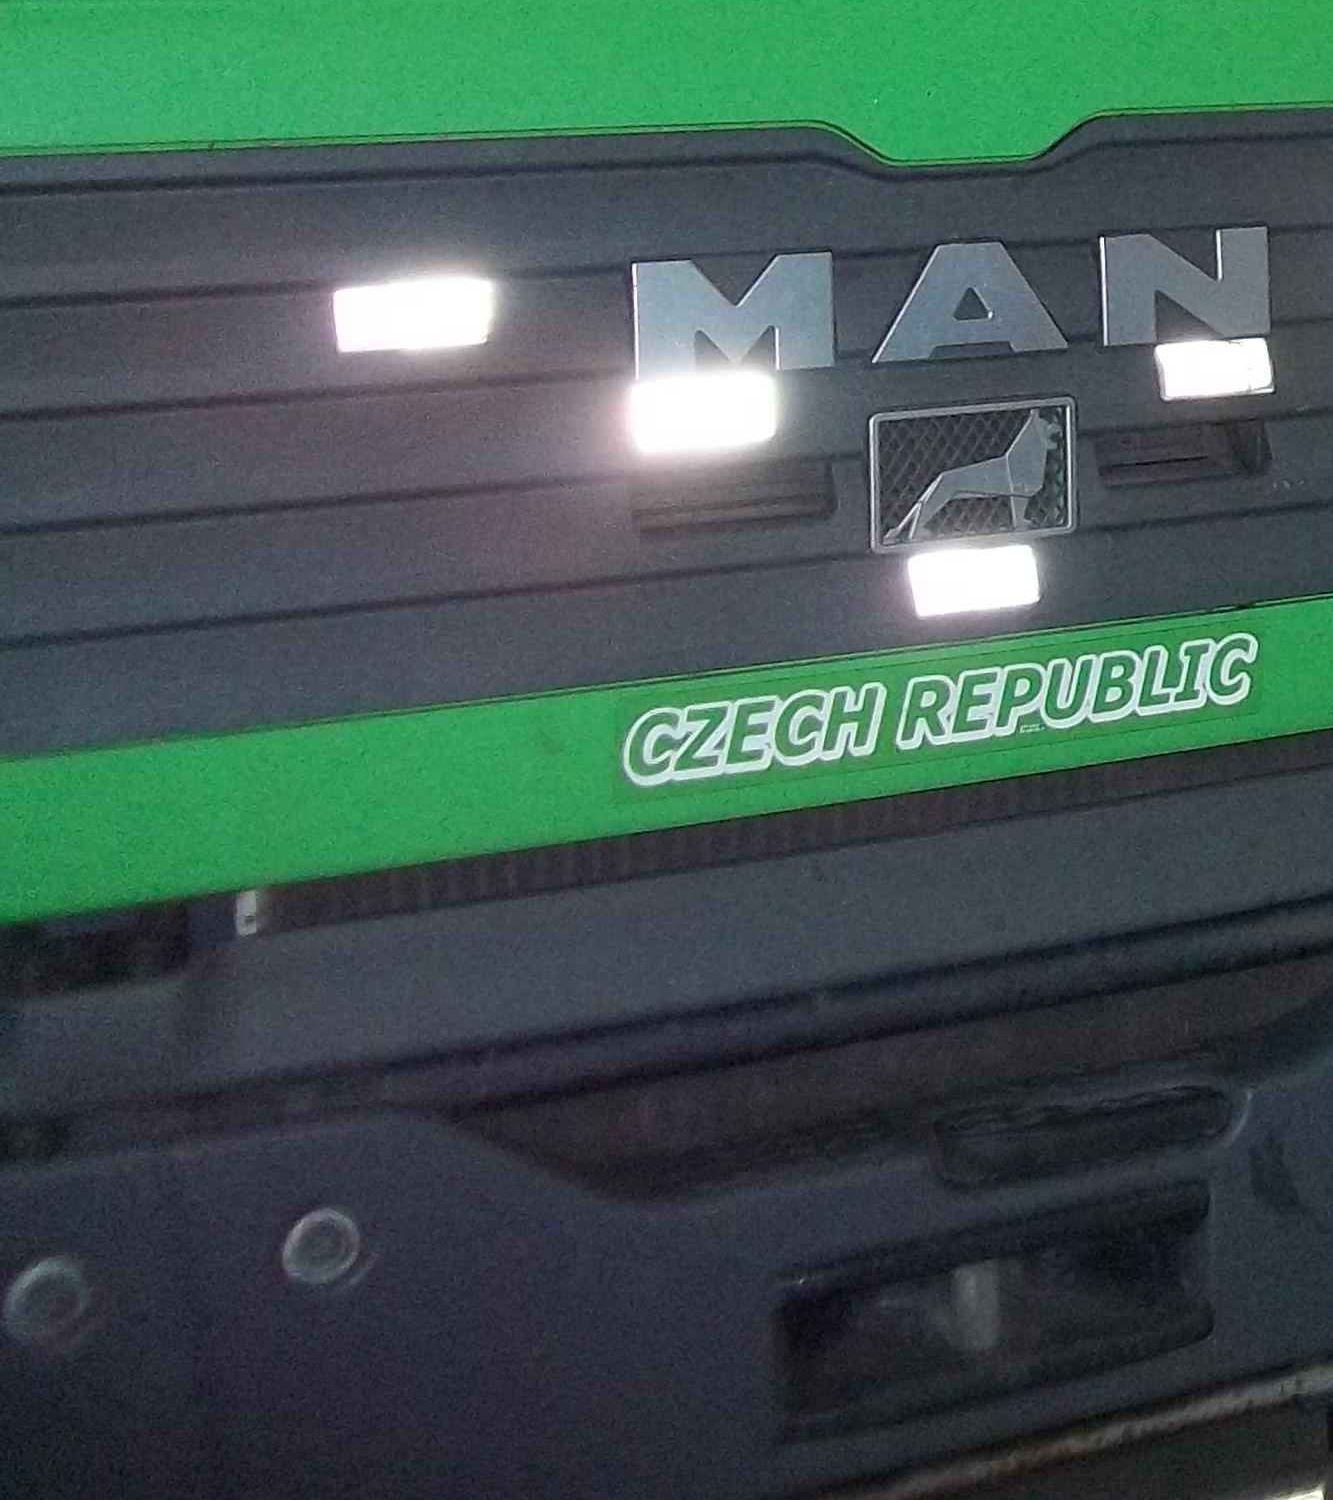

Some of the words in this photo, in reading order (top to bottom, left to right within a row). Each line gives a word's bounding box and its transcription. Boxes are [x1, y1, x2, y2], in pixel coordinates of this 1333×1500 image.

[632, 226, 1271, 379] MAN
[622, 682, 884, 787] CZECH
[896, 633, 1259, 751] REPUBLIC
